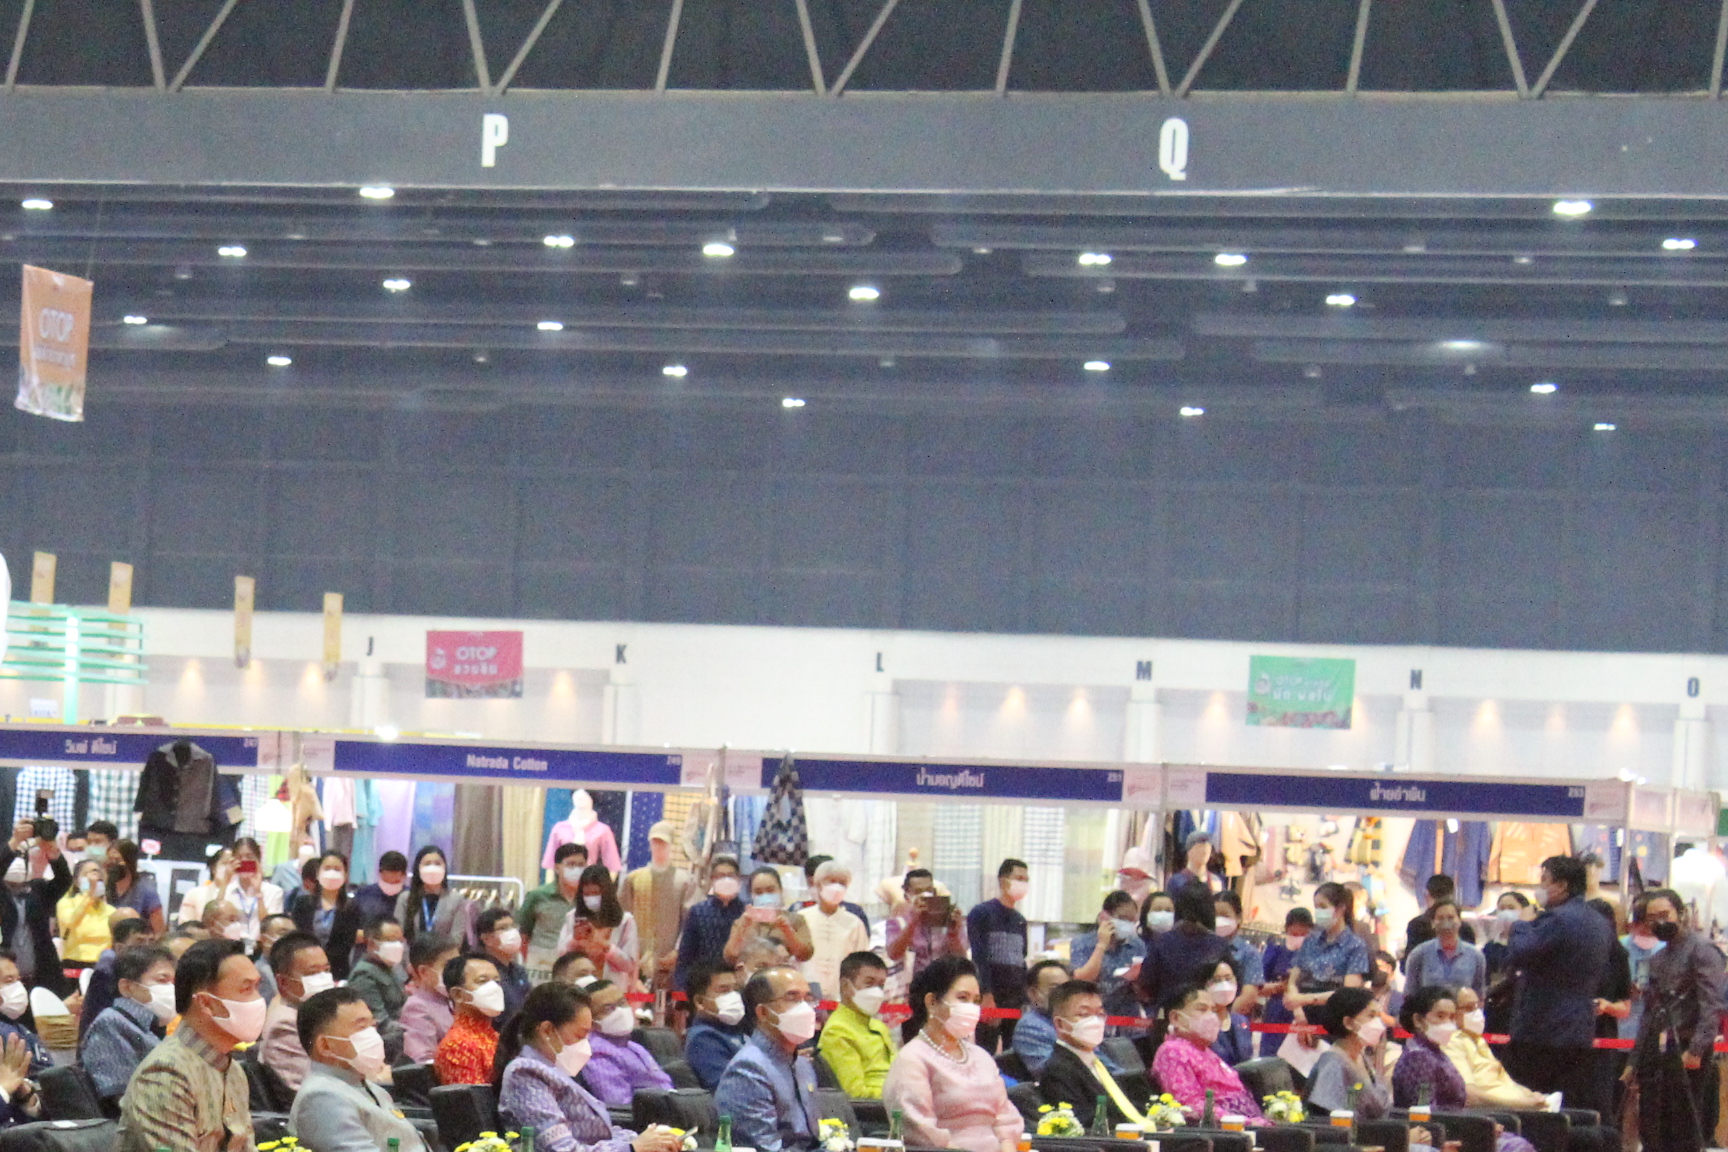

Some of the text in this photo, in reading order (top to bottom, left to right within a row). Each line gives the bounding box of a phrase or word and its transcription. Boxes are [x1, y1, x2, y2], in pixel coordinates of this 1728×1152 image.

[481, 113, 509, 167] P
[1159, 117, 1189, 181] Q
[39, 307, 75, 342] OTOP
[366, 635, 374, 657] J
[455, 645, 498, 661] OTOP
[615, 643, 627, 664] K
[875, 652, 885, 673] L
[1135, 660, 1153, 681] M
[1410, 669, 1423, 690] N
[513, 756, 548, 772] Cotton
